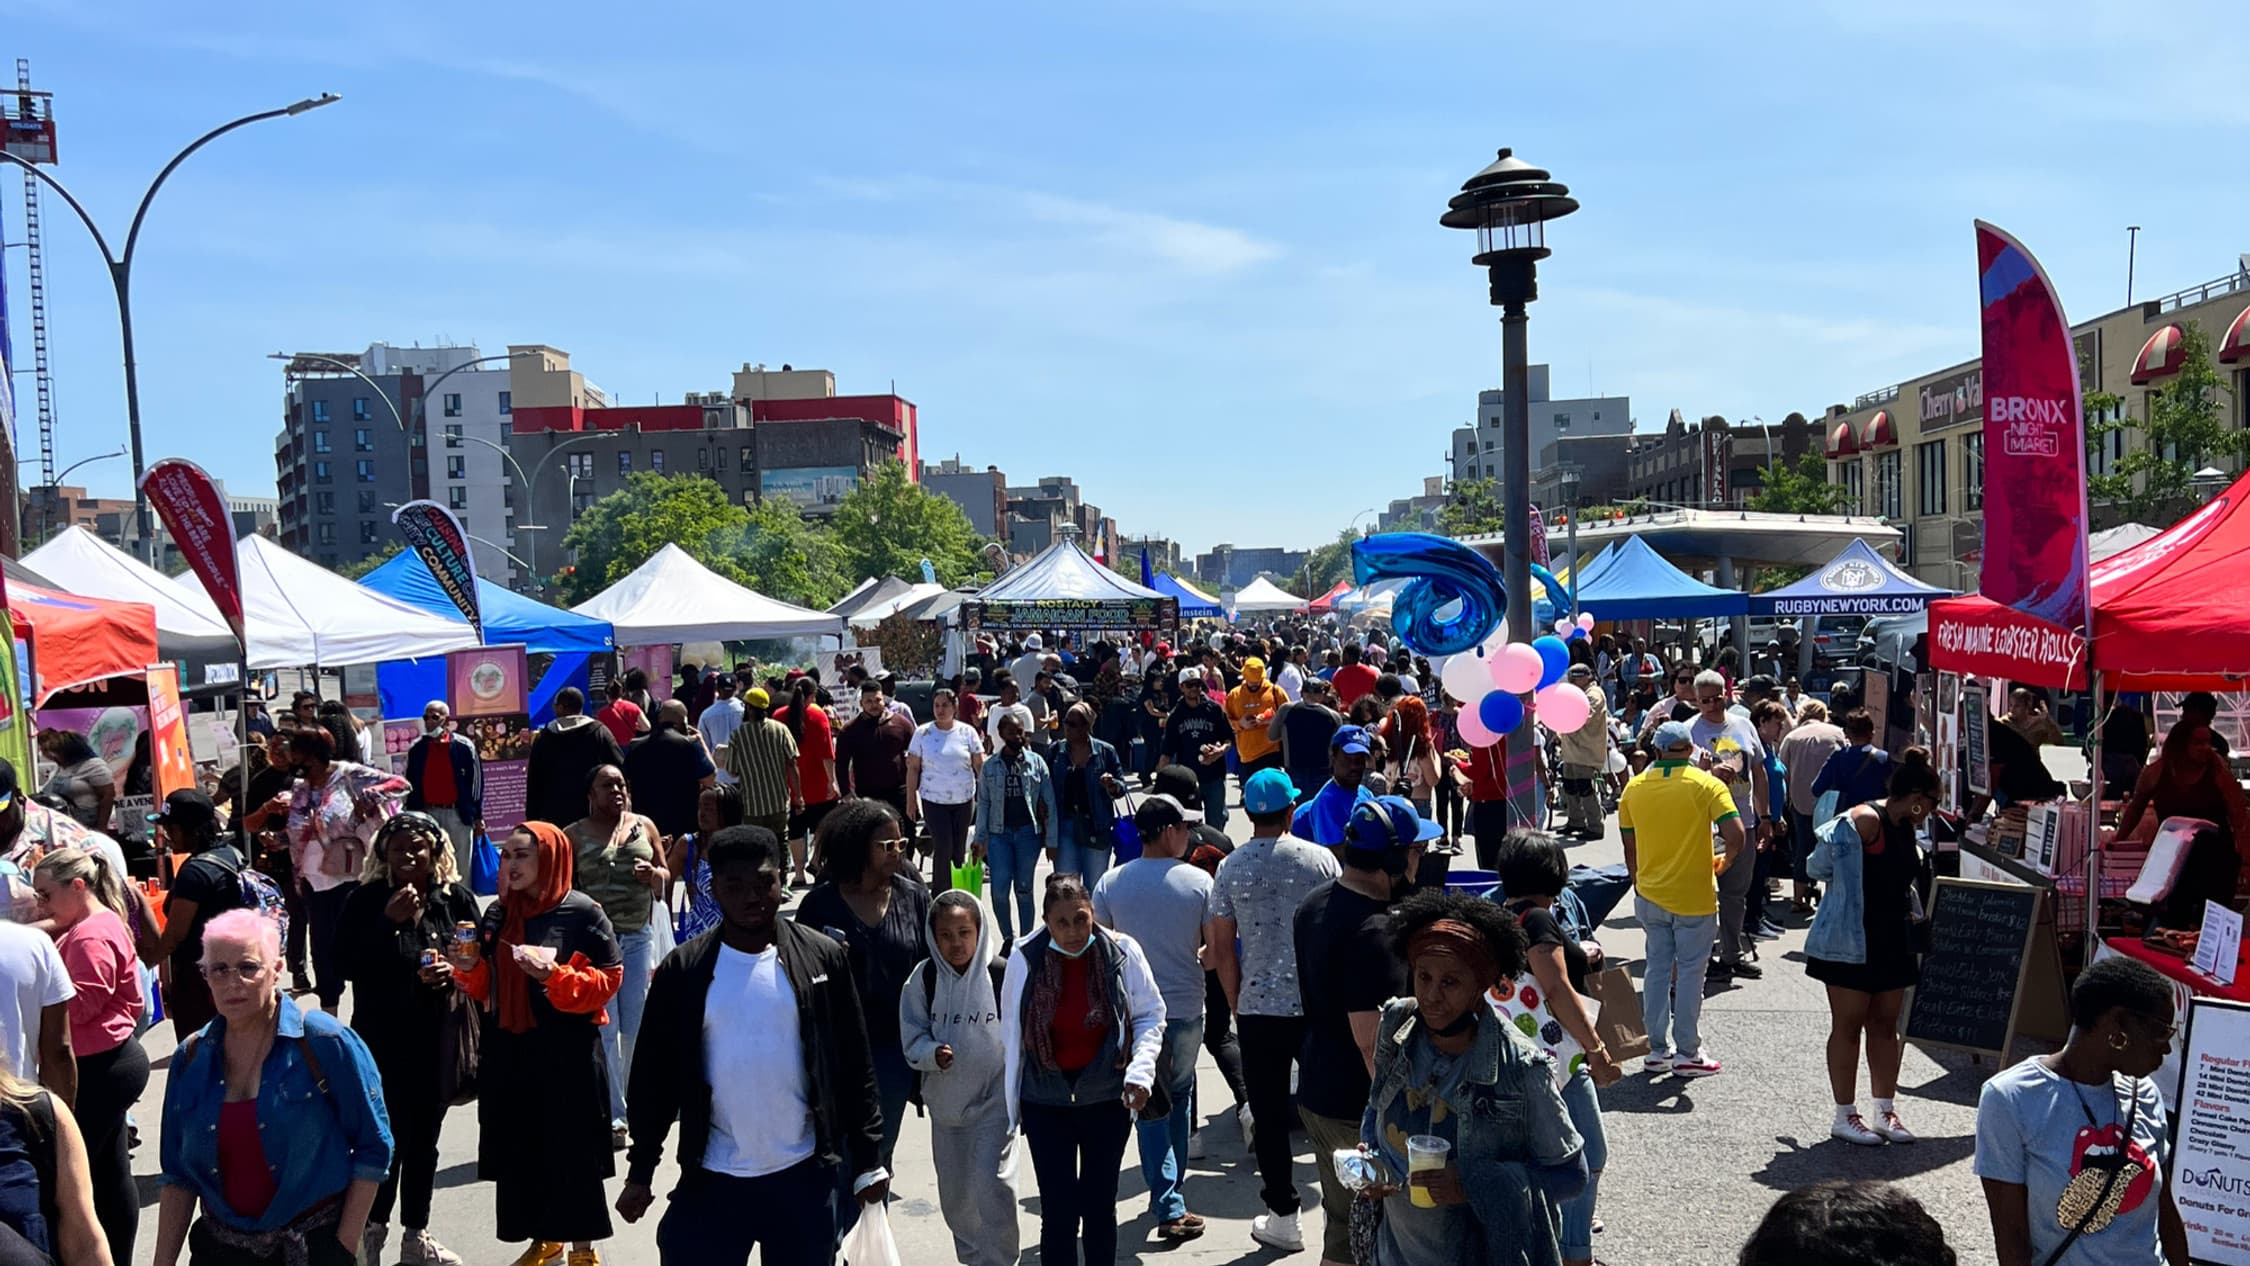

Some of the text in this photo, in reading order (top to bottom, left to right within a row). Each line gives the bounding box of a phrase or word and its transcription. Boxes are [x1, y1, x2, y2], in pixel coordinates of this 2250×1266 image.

[1920, 387, 1956, 422] Cherry
[1991, 396, 2067, 424] BRONX
[427, 508, 464, 557] CUISINE
[425, 527, 469, 584] CULTURE
[422, 546, 478, 621] COMMUNITY
[1036, 600, 1098, 608] ROSTACY
[1775, 598, 1924, 614] RUGBYNEWYORK.COM
[1014, 608, 1130, 621] JAMAICAN FOOD
[1938, 619, 1964, 652] FRESH
[1994, 624, 2038, 664] LOBSTER
[2201, 1053, 2239, 1066] Regular
[2209, 1074, 2225, 1082] Mini
[2208, 1083, 2223, 1091] Mini
[2194, 1099, 2230, 1112] Flavors
[2224, 1094, 2249, 1104] Donuts
[2192, 1109, 2217, 1119] Funnel
[2219, 1114, 2237, 1123] Cake
[2191, 1119, 2228, 1130] Cinnamon
[2190, 1127, 2227, 1139] Chocolate
[2189, 1136, 2209, 1146] Crazy
[2179, 1196, 2215, 1211] Donuts
[2217, 1204, 2235, 1215] For
[2183, 1221, 2208, 1233] rinks
